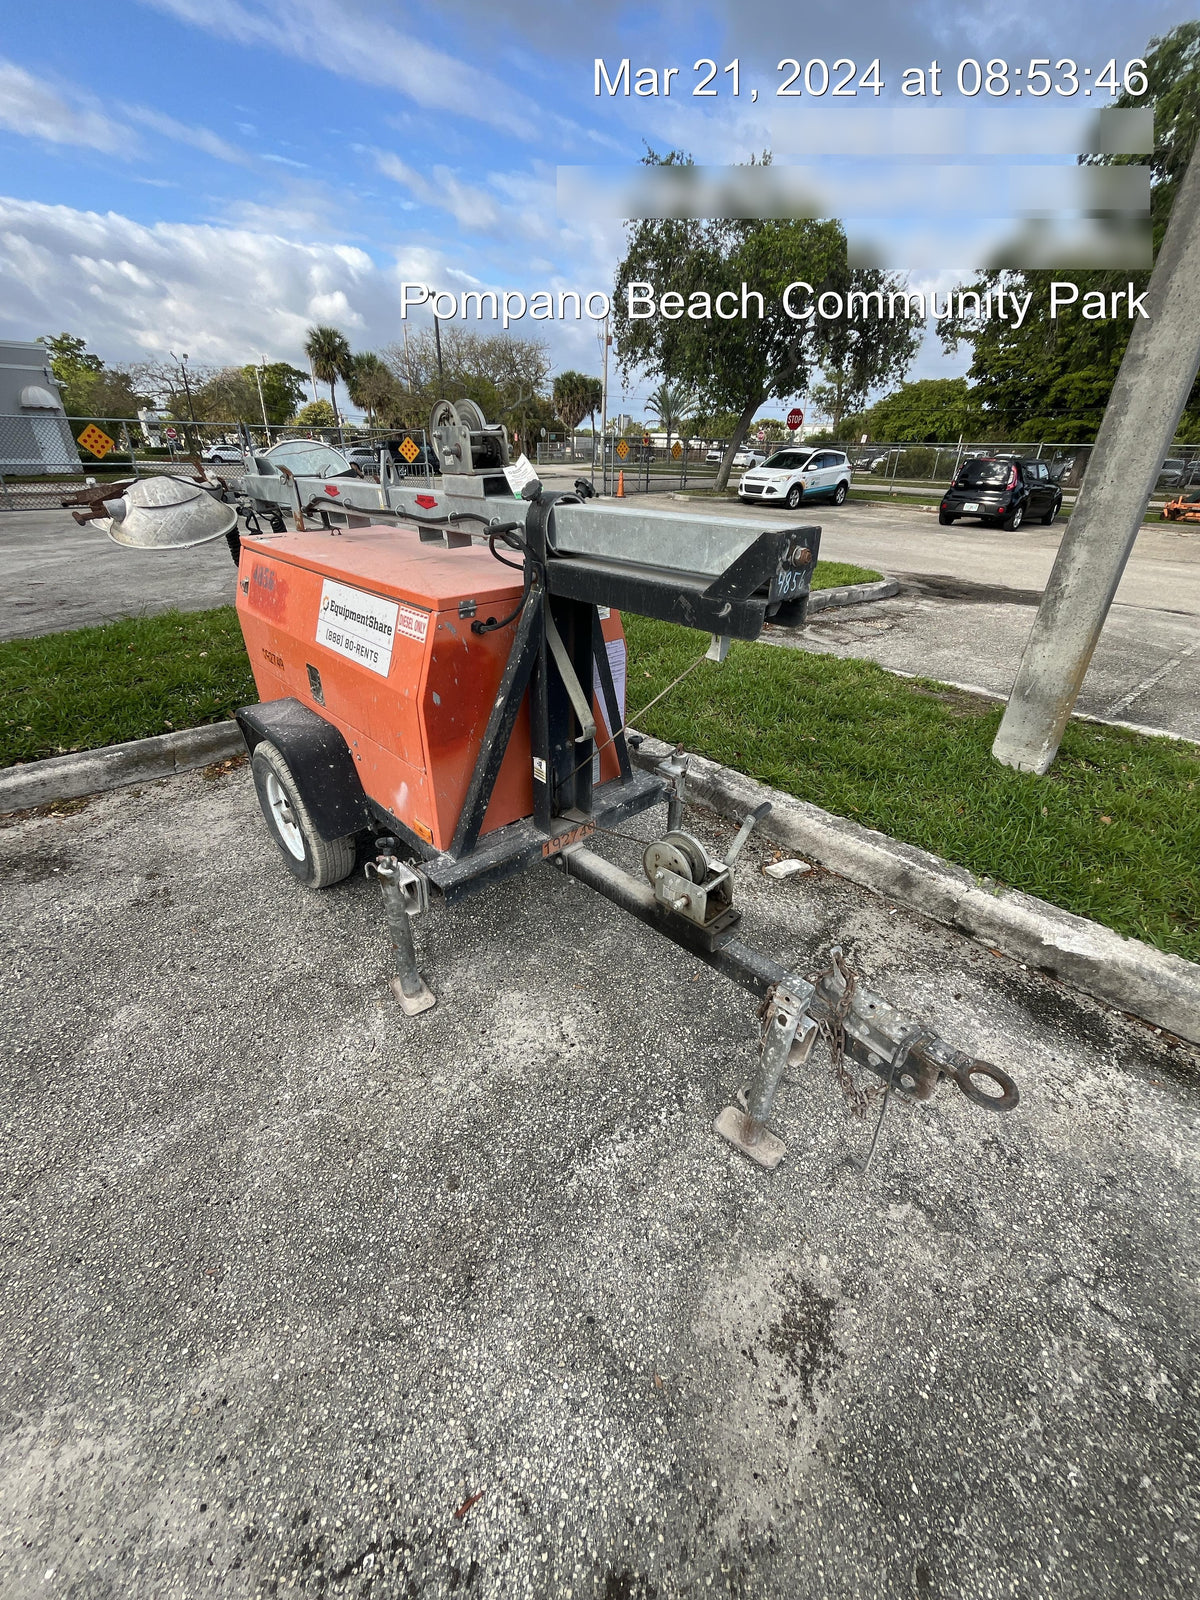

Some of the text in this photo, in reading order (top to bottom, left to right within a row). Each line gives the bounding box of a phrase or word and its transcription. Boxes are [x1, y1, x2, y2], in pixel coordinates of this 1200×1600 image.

[787, 415, 802, 424] STOP
[329, 600, 393, 636] EquipmentShare
[399, 613, 427, 635] DIESEL ONLY
[325, 628, 379, 663] (888) 80-RENTS
